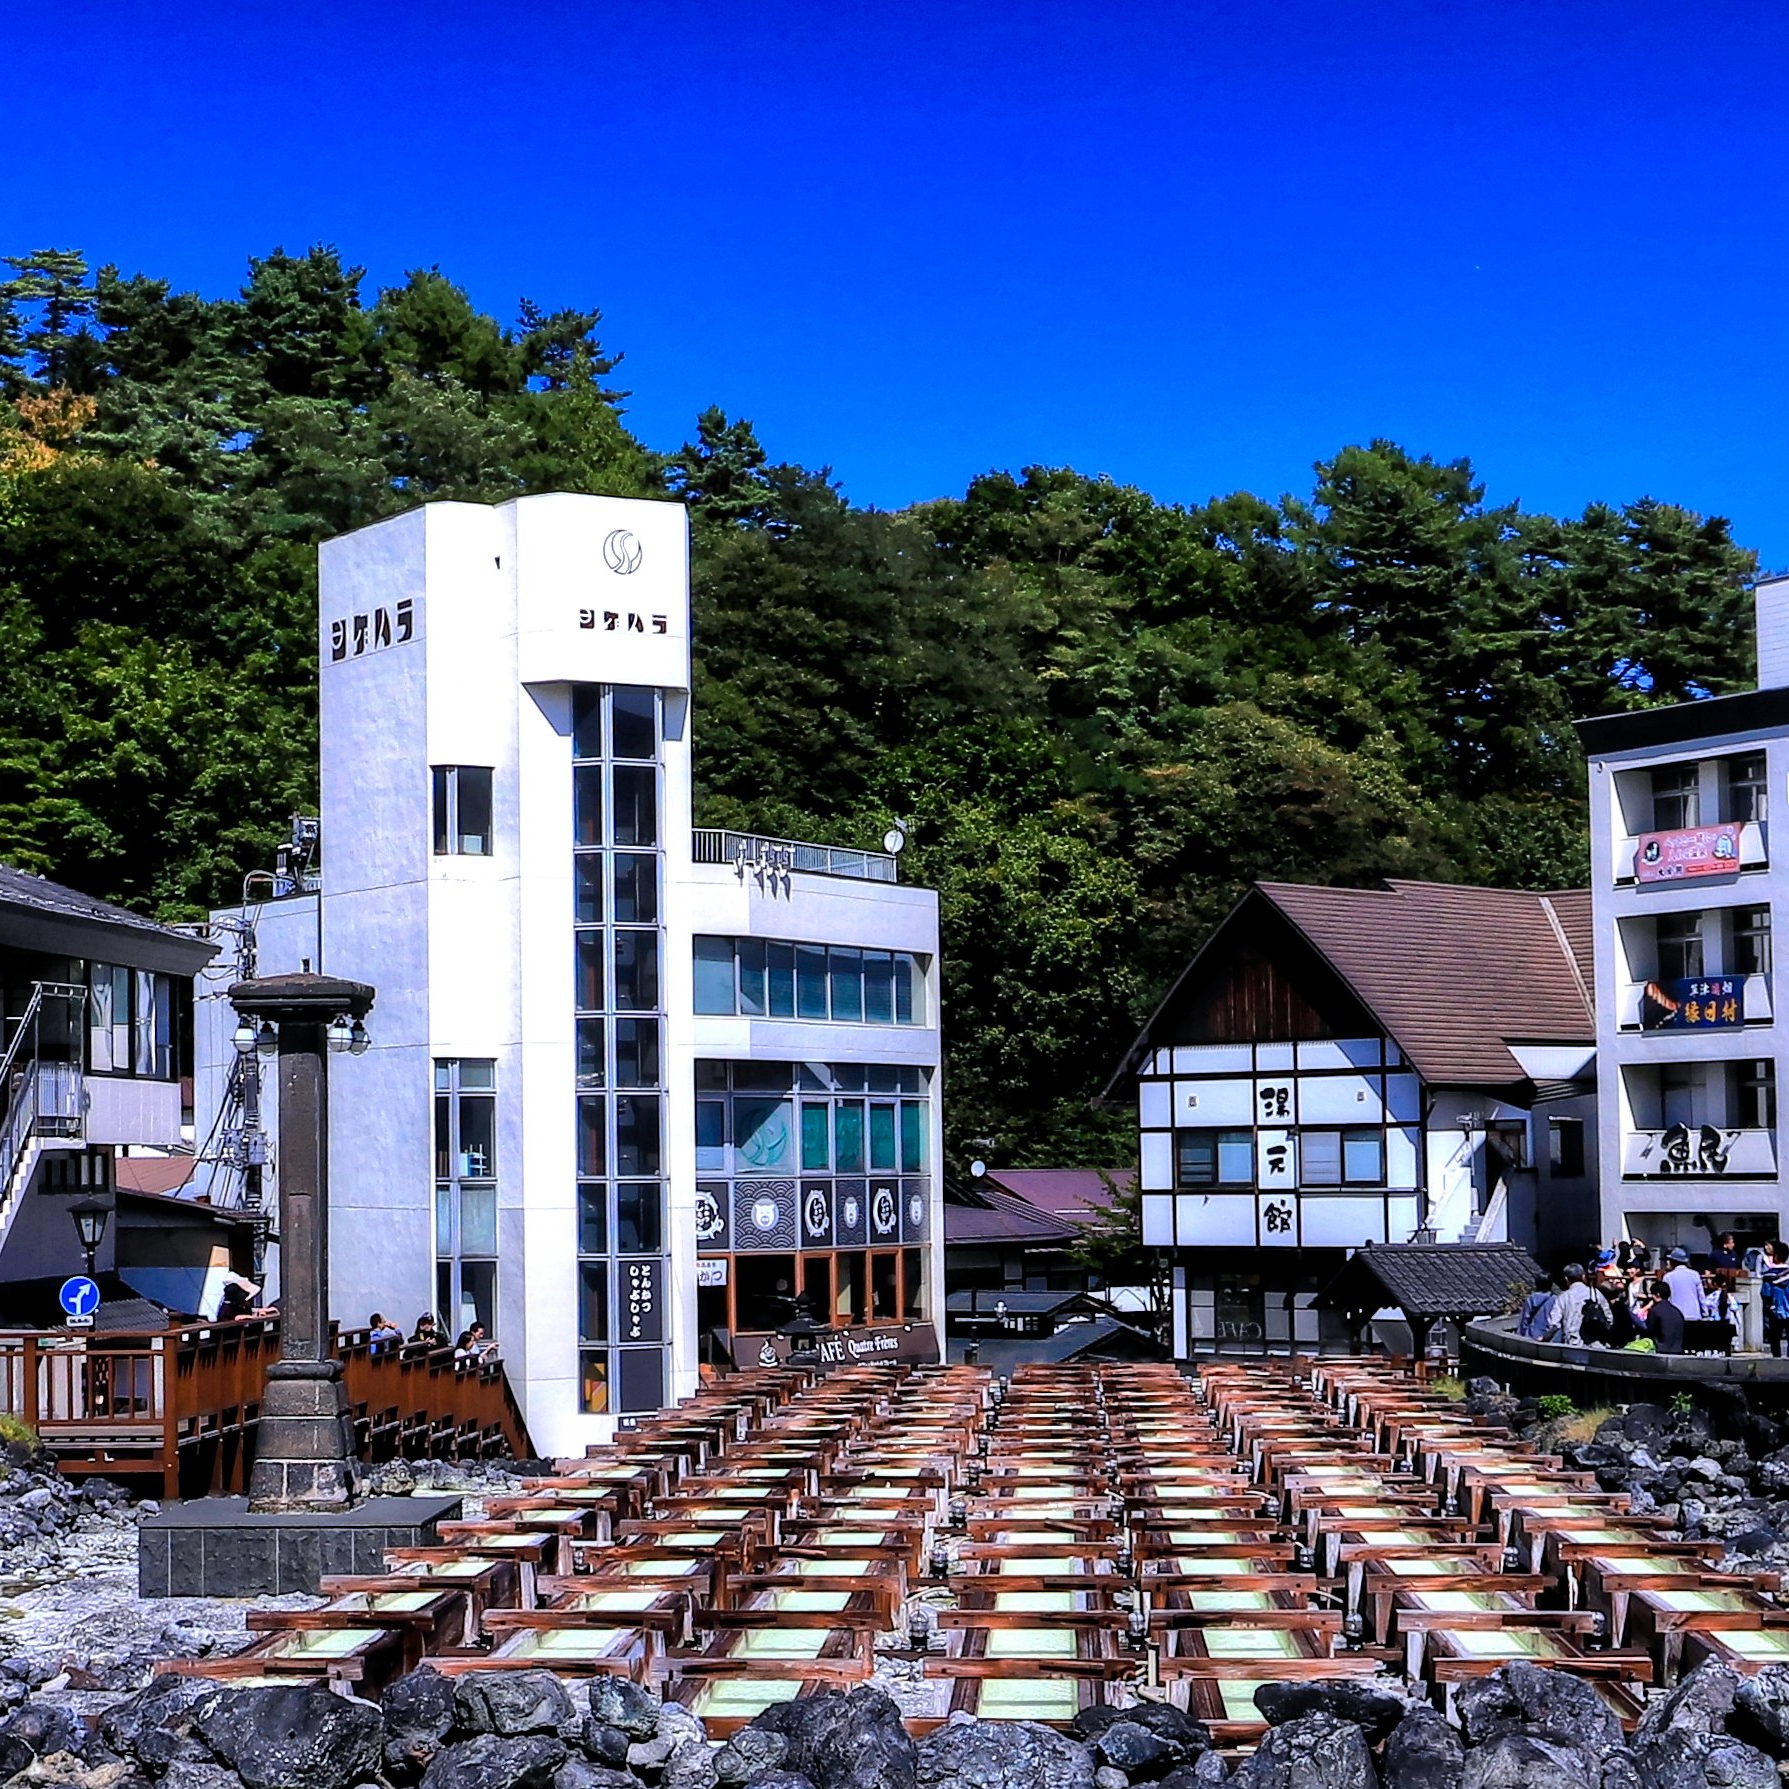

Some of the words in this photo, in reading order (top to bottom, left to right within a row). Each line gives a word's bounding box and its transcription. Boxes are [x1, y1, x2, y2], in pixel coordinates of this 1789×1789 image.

[1259, 1087, 1293, 1233] 湯元館
[628, 1264, 642, 1339] しゃぶしゃぶ
[640, 1264, 653, 1314] とんかつ
[815, 1334, 846, 1363] AFÉ
